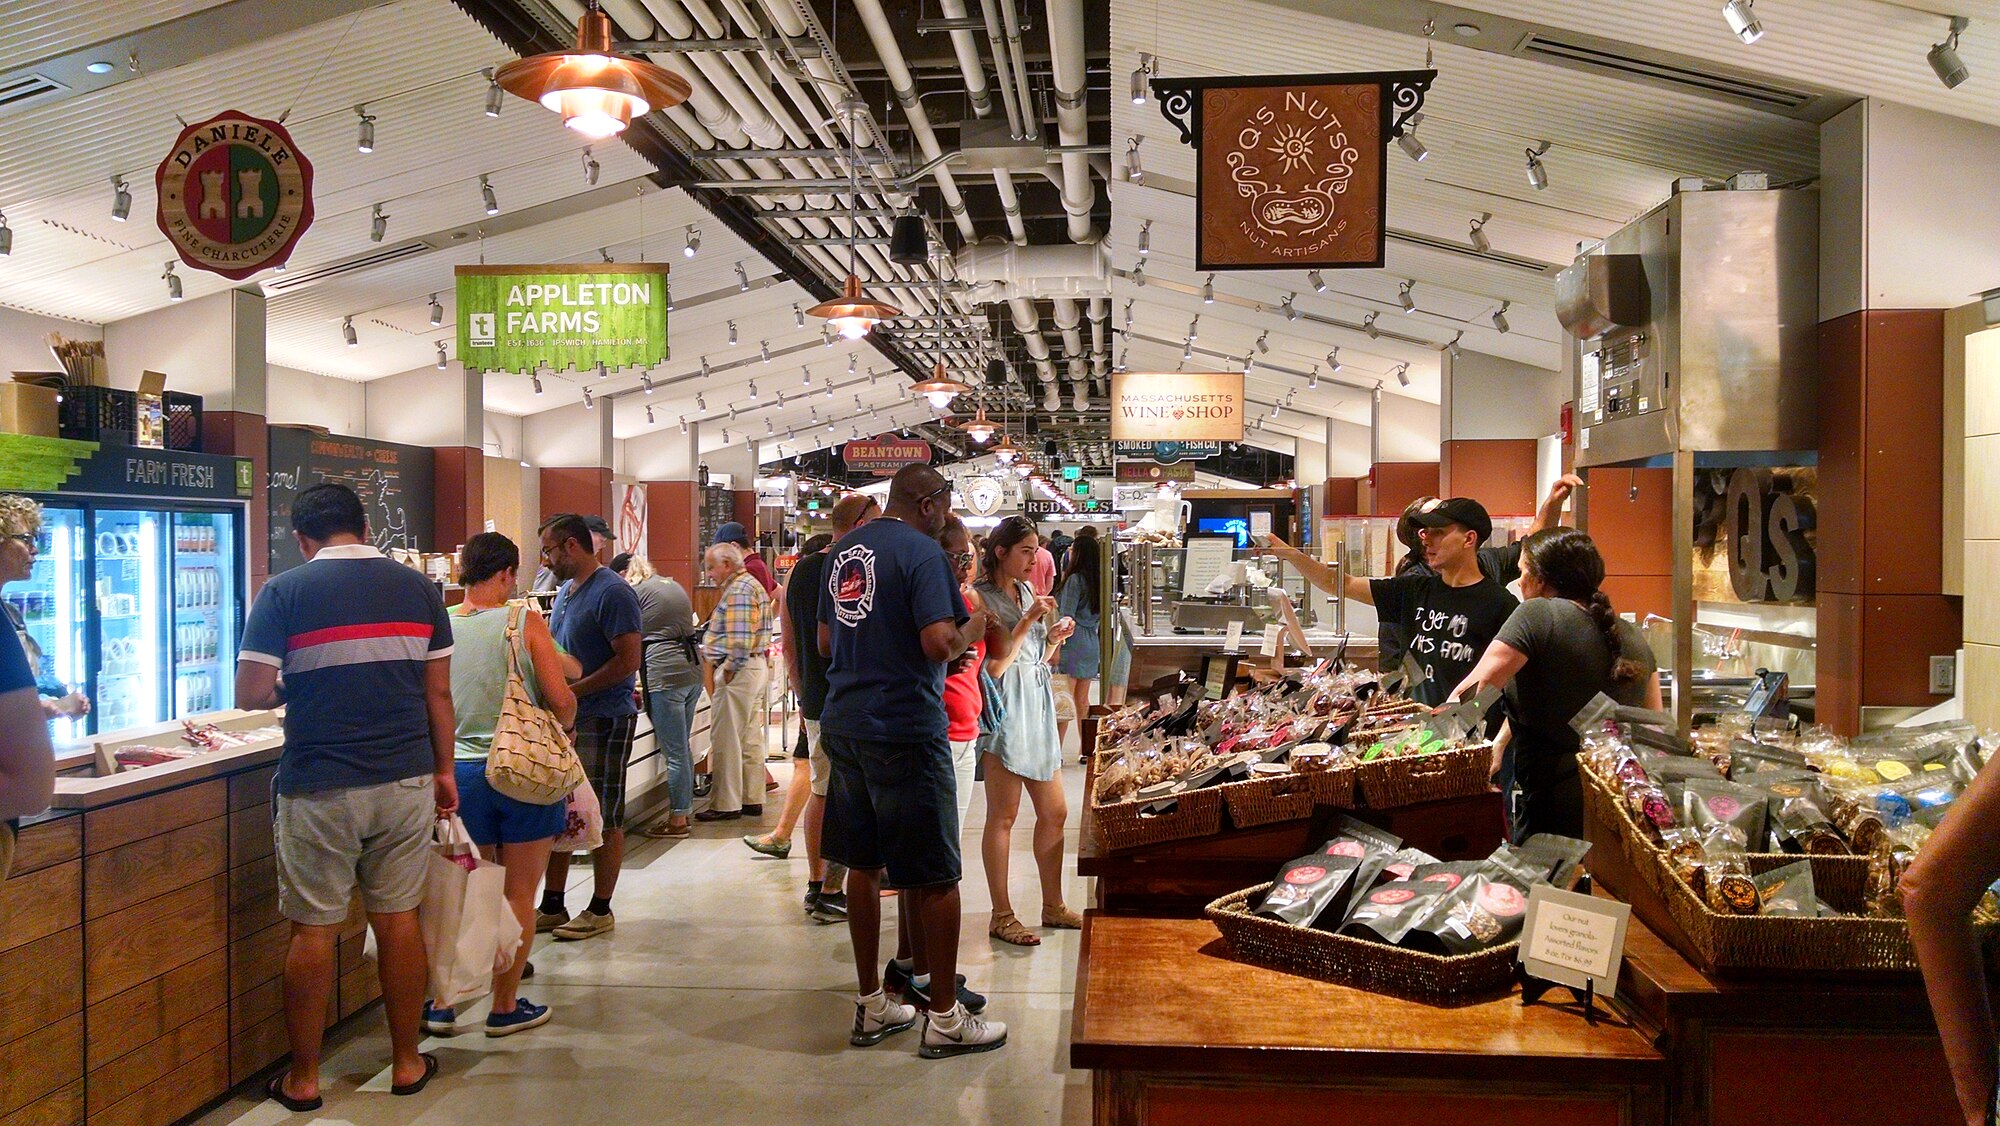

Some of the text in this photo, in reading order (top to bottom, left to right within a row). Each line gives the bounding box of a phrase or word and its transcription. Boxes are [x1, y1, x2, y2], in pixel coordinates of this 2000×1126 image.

[1238, 91, 1348, 150] Q'S NUTS
[175, 124, 290, 170] DANIELE
[175, 215, 292, 261] FINE CHARCUTERIE
[1240, 219, 1347, 257] NUT ARTISANS
[506, 283, 650, 306] APPLETON
[507, 310, 600, 334] FARMS
[1121, 394, 1233, 403] MASSACHUSETTS
[1121, 406, 1233, 419] WINE SHOP
[852, 446, 923, 458] BEANTOWN
[1117, 440, 1152, 450] SMOKED
[1185, 440, 1204, 450] FISH
[126, 458, 214, 489] FARM FRESH
[858, 461, 902, 469] PASTRAMI
[1415, 607, 1424, 621] I
[1422, 609, 1449, 632] get
[1549, 921, 1569, 933] lovers
[1562, 913, 1589, 926] Our nut
[1544, 935, 1575, 949] Assorted
